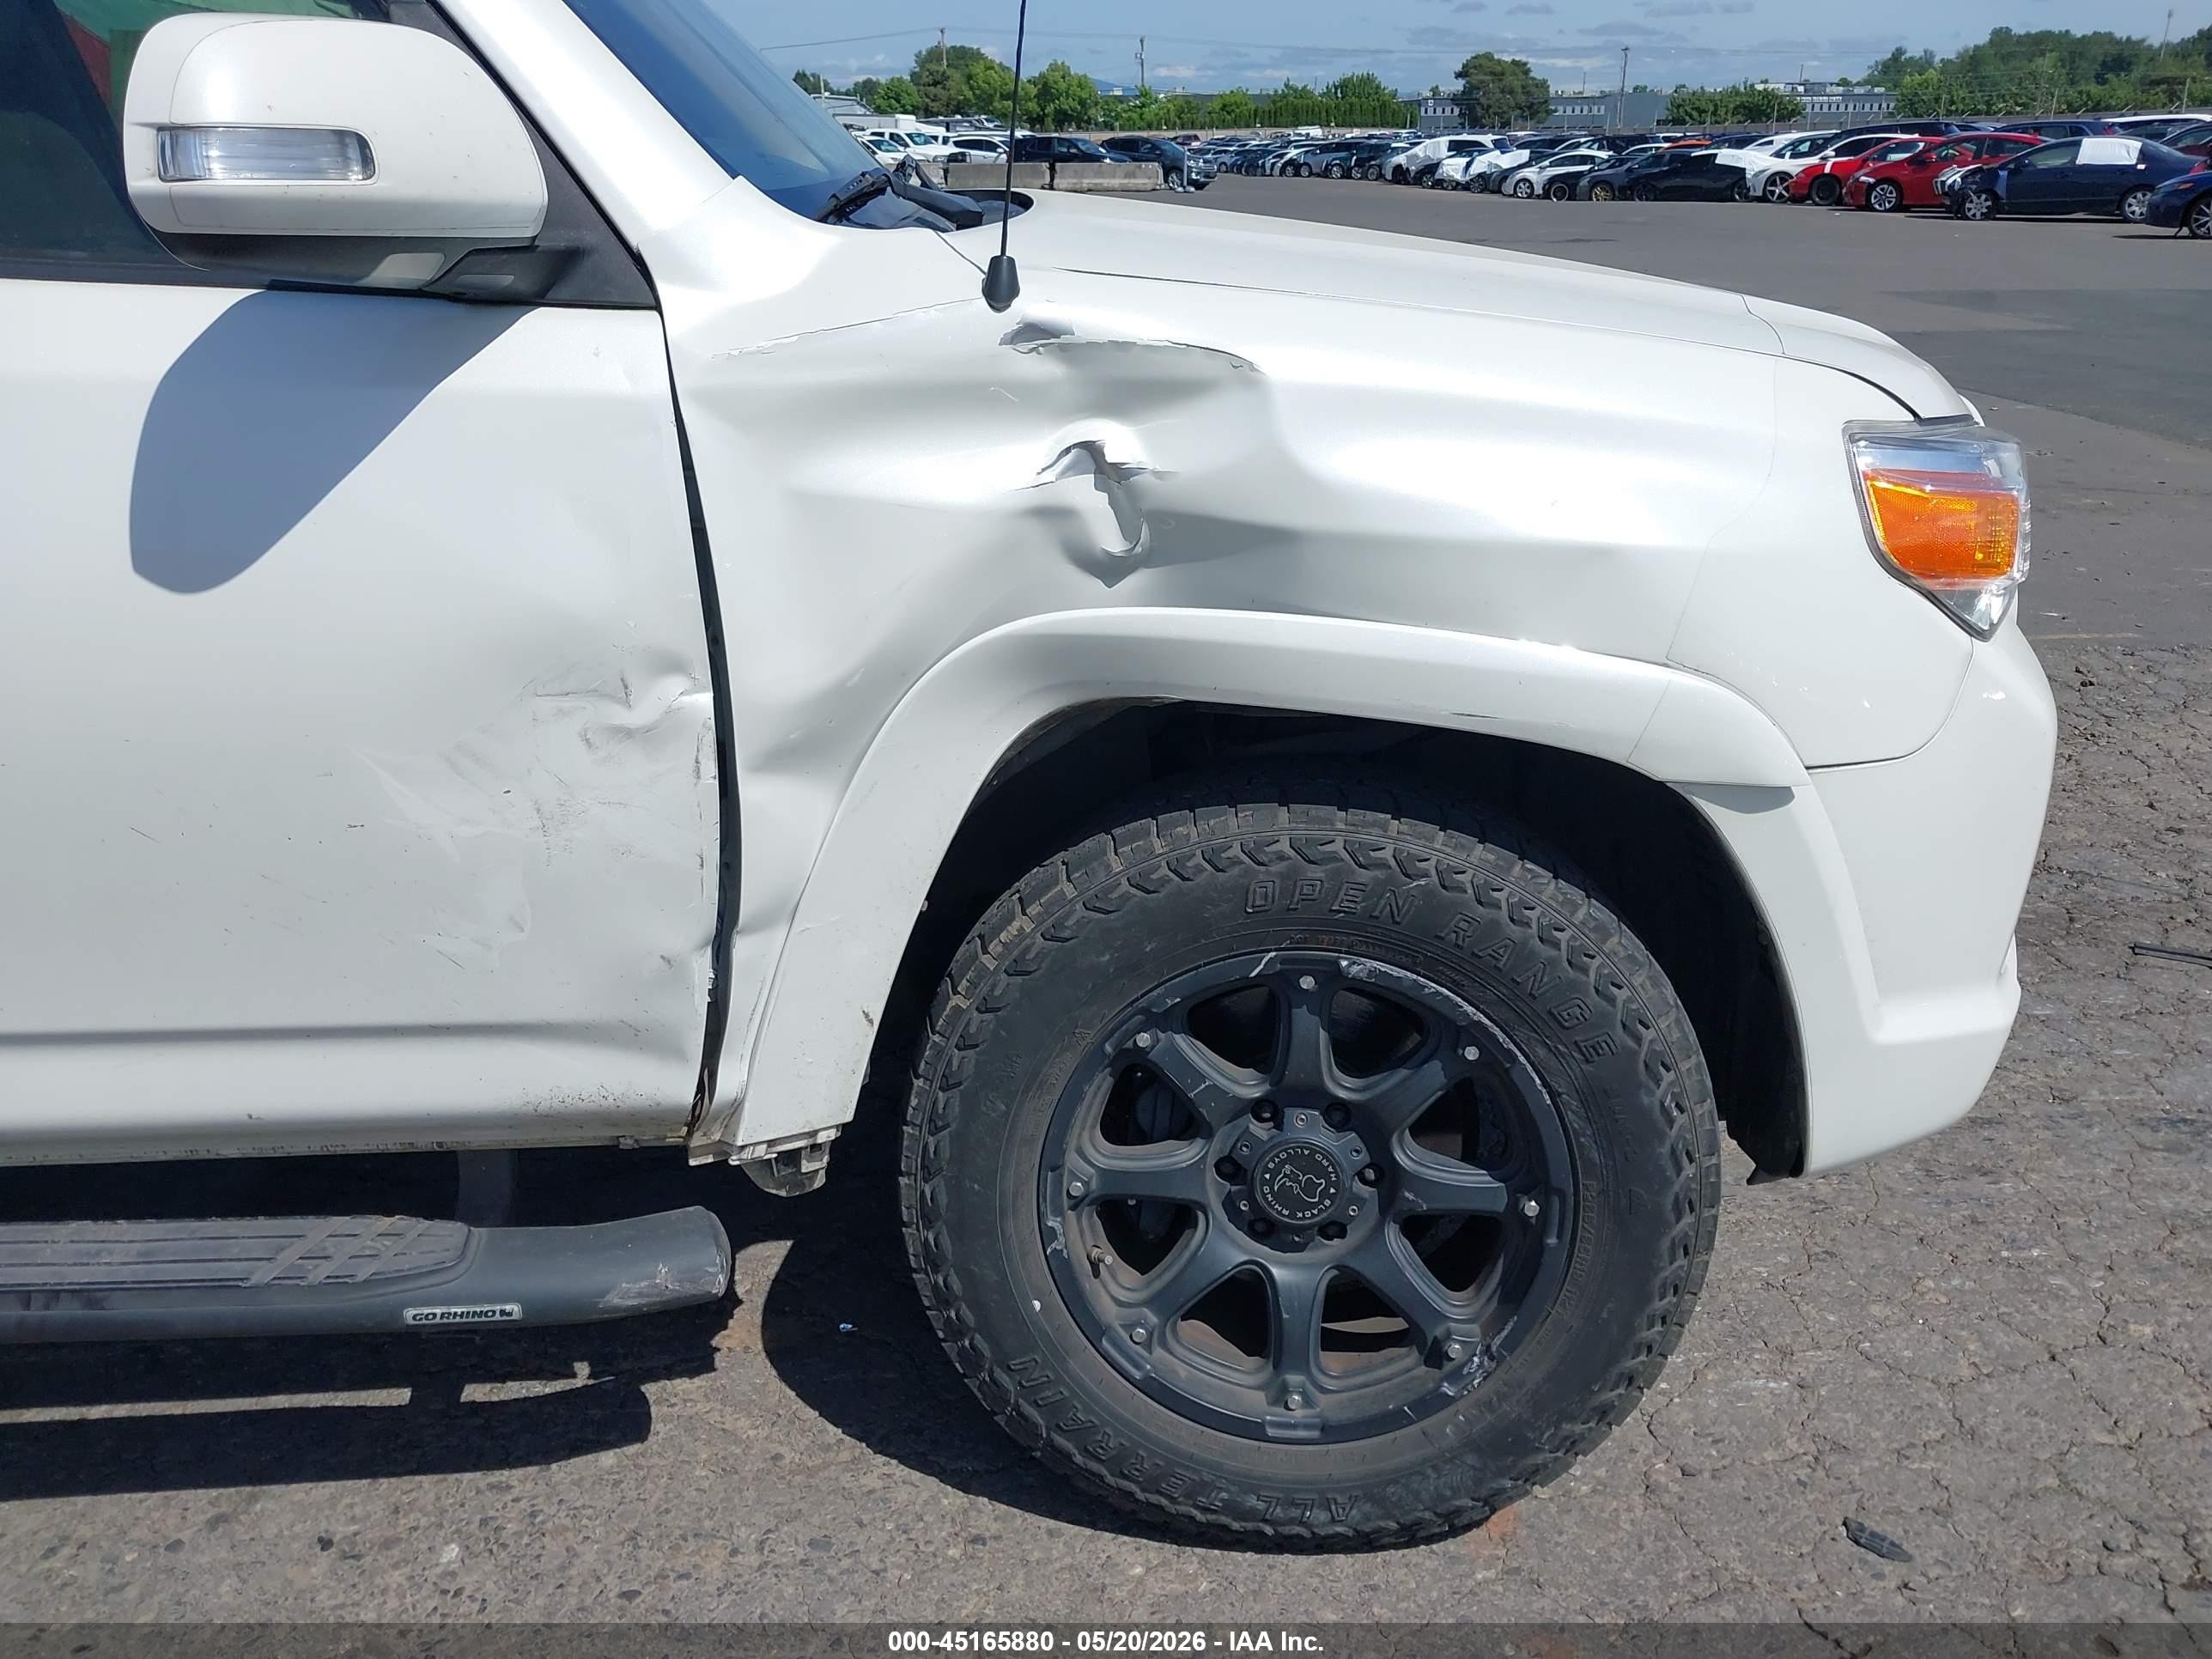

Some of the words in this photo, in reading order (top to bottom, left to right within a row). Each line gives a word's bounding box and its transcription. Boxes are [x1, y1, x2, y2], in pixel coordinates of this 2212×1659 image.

[1245, 878, 1417, 925] OPEN
[1433, 912, 1620, 1064] RANGE
[1267, 1148, 1310, 1169] ALLOYS
[1315, 1153, 1338, 1182] HARD
[1262, 1185, 1290, 1216] RHINO
[1296, 1199, 1332, 1218] BLACK
[411, 1312, 437, 1322] GO
[439, 1310, 496, 1321] RHINO
[1007, 1356, 1231, 1511] TERRAIN
[1255, 1492, 1364, 1525] ALL
